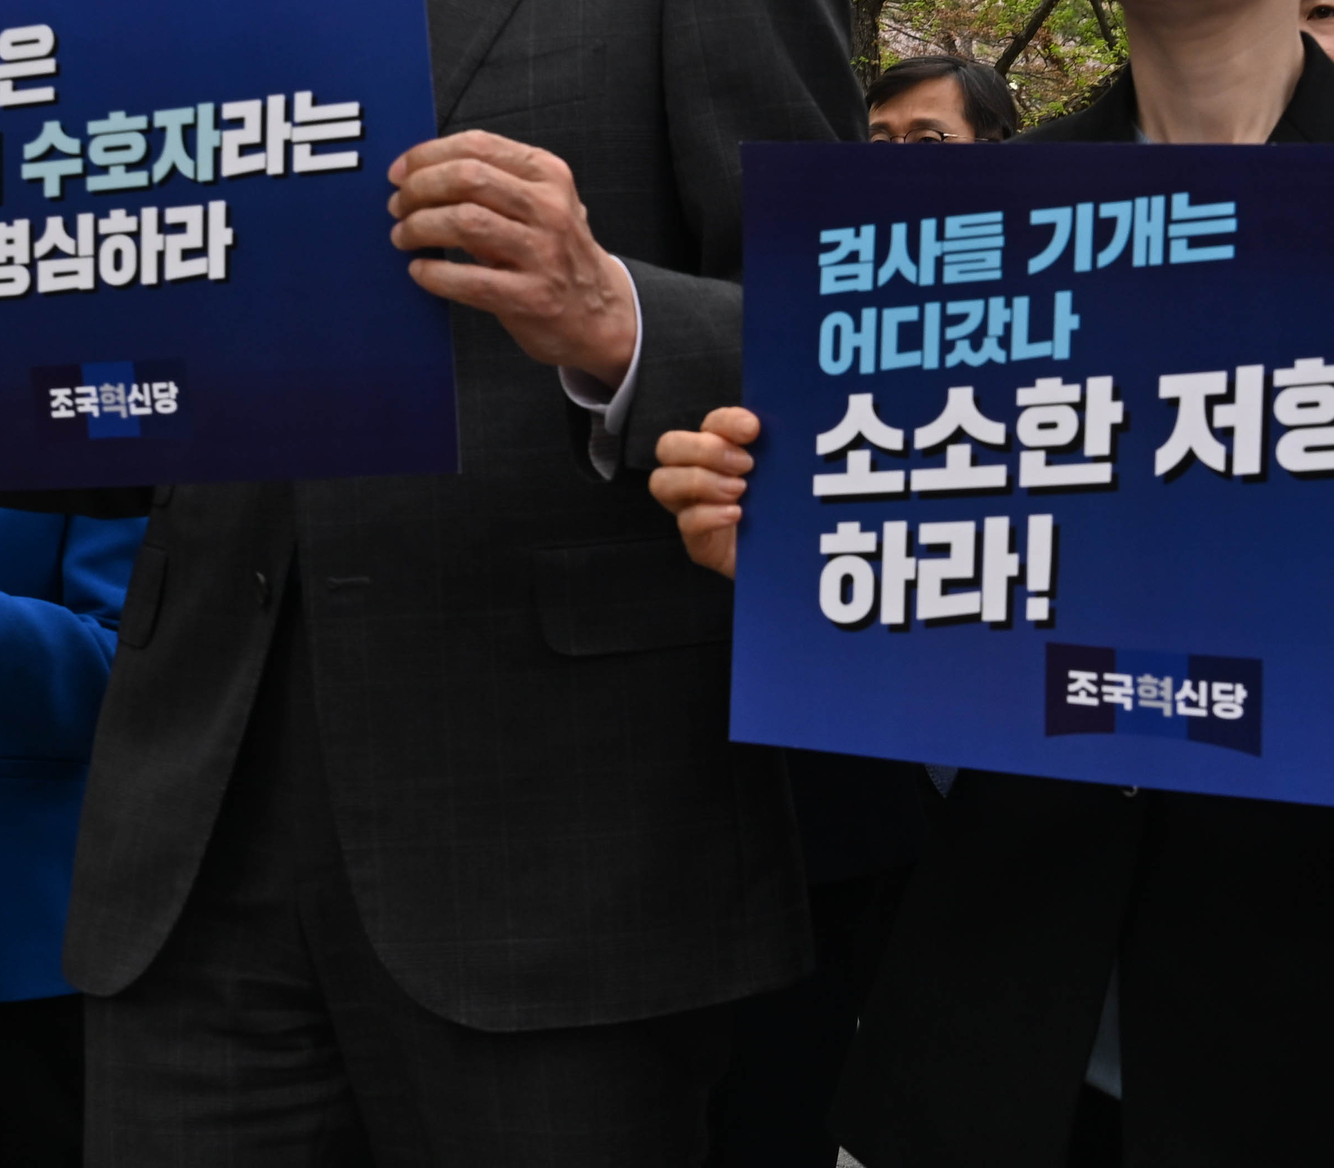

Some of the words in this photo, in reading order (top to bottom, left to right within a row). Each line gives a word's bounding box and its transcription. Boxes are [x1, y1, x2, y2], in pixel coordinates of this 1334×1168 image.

[20, 90, 362, 200] 수호자라는
[818, 211, 1005, 295] 검사들
[1027, 192, 1238, 274] 기개는
[818, 291, 1080, 375] 어디갔나
[49, 381, 180, 419] 조국혁신당
[812, 376, 1124, 496] 소소한
[818, 514, 1054, 625] 하라!
[1067, 672, 1248, 720] 조국혁신당
